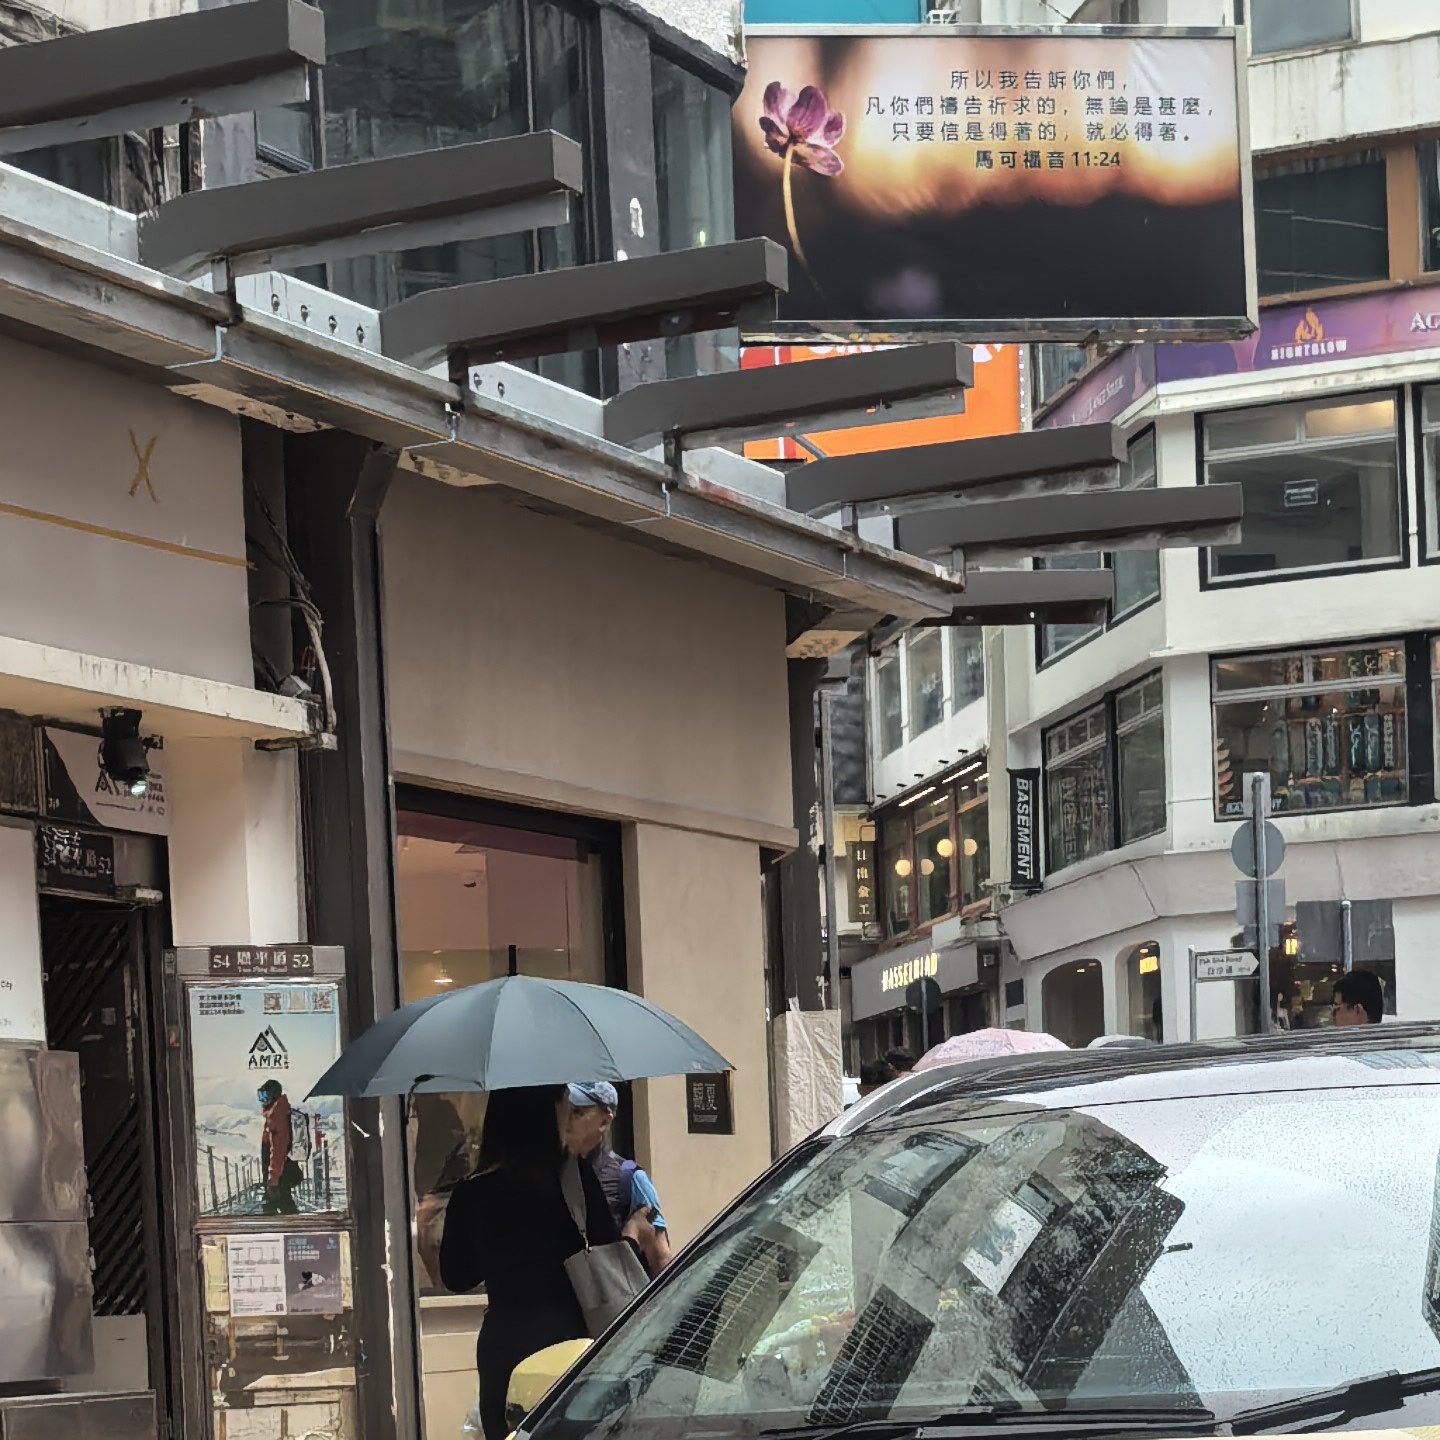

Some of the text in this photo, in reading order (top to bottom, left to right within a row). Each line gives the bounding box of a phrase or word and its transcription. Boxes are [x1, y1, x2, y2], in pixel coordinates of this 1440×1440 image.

[1073, 151, 1121, 167] 11:24
[1016, 777, 1030, 880] BASEMENT
[213, 954, 231, 969] 54
[292, 954, 310, 969] 52
[248, 1054, 282, 1068] AMR
